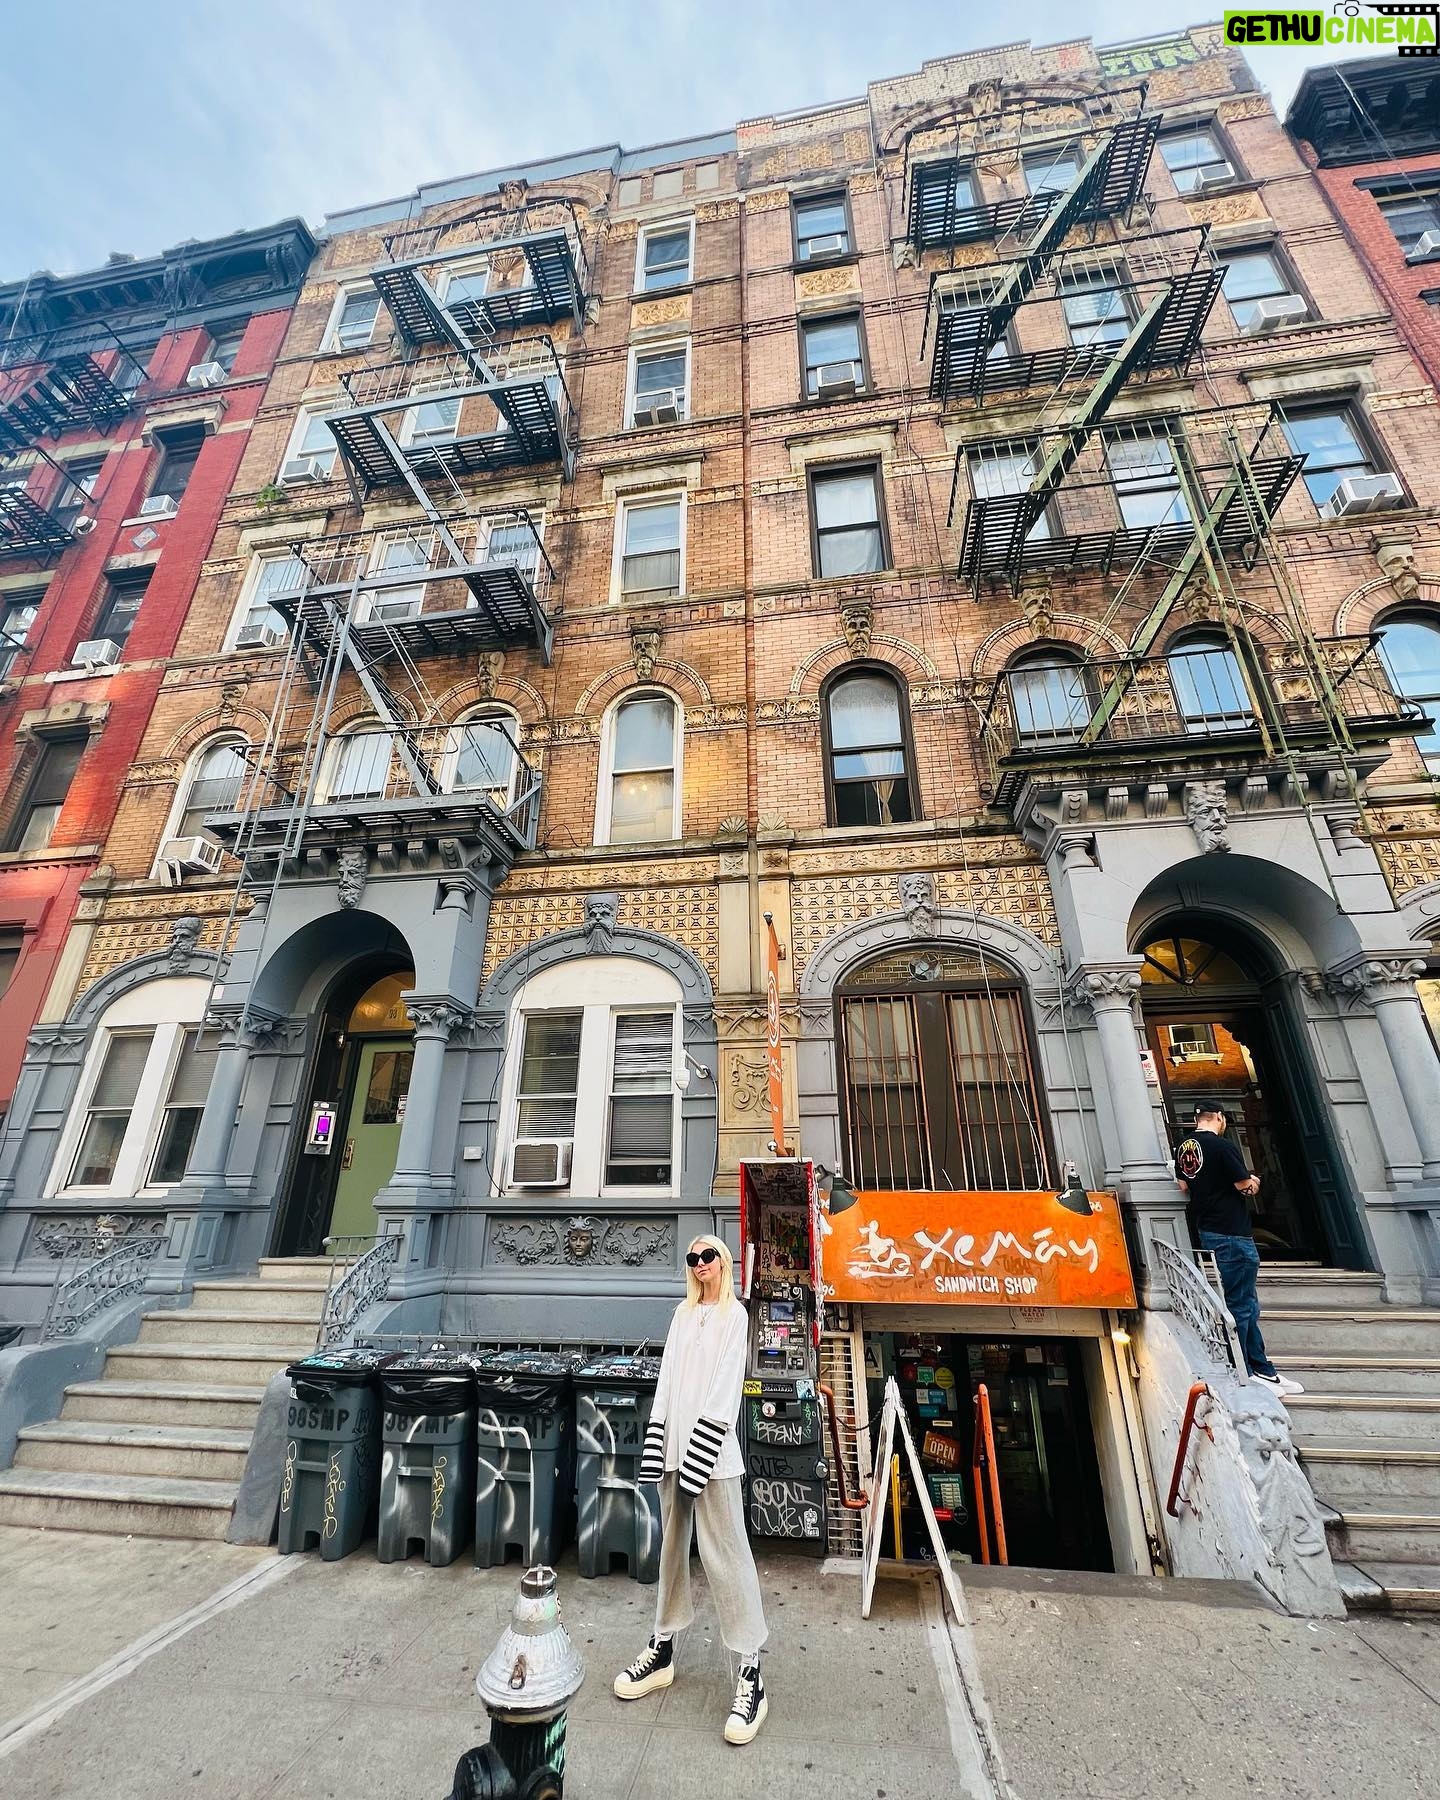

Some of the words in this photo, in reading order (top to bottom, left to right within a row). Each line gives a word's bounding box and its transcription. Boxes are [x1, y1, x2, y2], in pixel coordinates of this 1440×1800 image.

[934, 1275, 1000, 1294] SANDWICH
[1004, 1276, 1038, 1295] SHOP
[930, 1440, 956, 1461] OPEN
